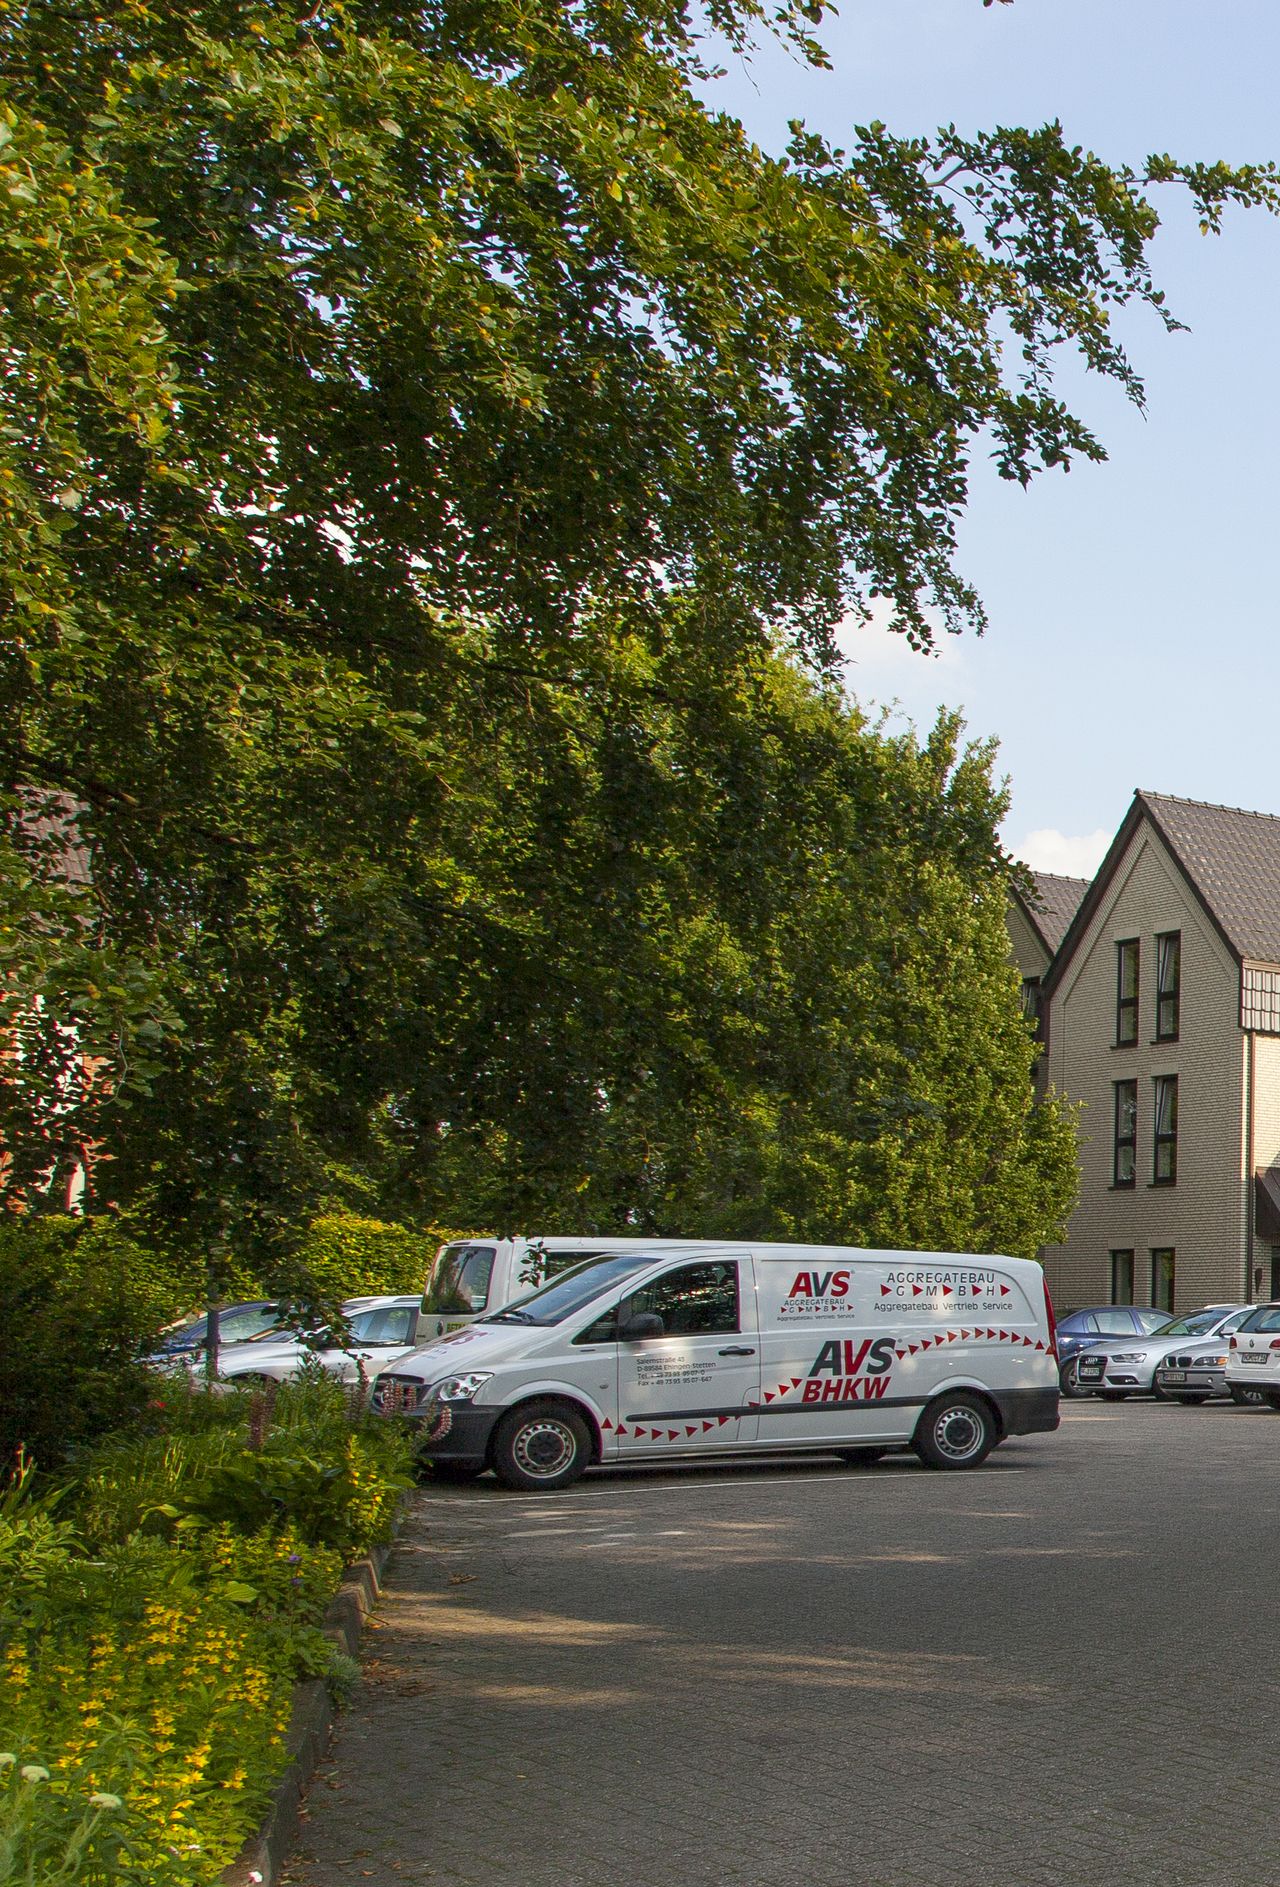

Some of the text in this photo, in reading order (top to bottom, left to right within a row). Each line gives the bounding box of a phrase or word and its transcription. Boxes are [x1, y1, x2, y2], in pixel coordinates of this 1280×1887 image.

[788, 1270, 851, 1298] AVS
[887, 1272, 995, 1284] AGGREGATEBAU
[784, 1298, 845, 1307] AGGREGATEBAU
[873, 1301, 1013, 1312] Aggregatebau Vertrieb Service
[807, 1337, 897, 1378] AVS
[801, 1376, 892, 1404] BHKW
